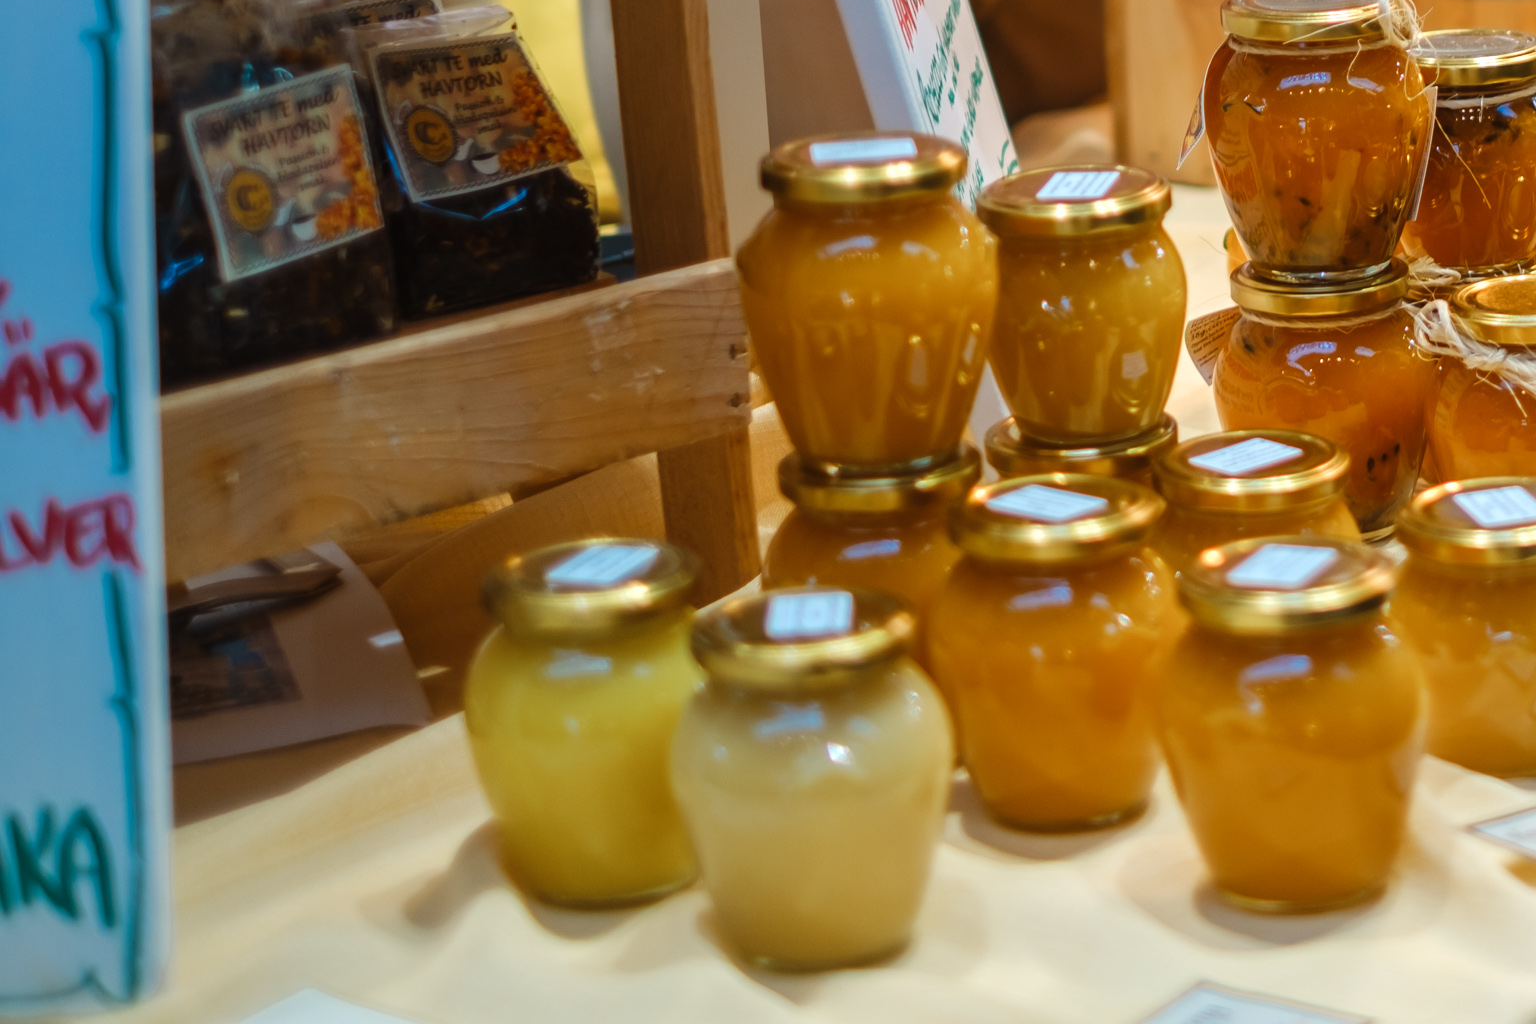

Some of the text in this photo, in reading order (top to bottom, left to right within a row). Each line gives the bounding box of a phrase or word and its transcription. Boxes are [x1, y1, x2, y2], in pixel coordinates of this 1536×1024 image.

[444, 55, 463, 72] TE
[469, 48, 508, 68] med
[296, 83, 341, 112] med
[418, 71, 503, 99] HAVTORN
[239, 113, 332, 158] HAVTORN
